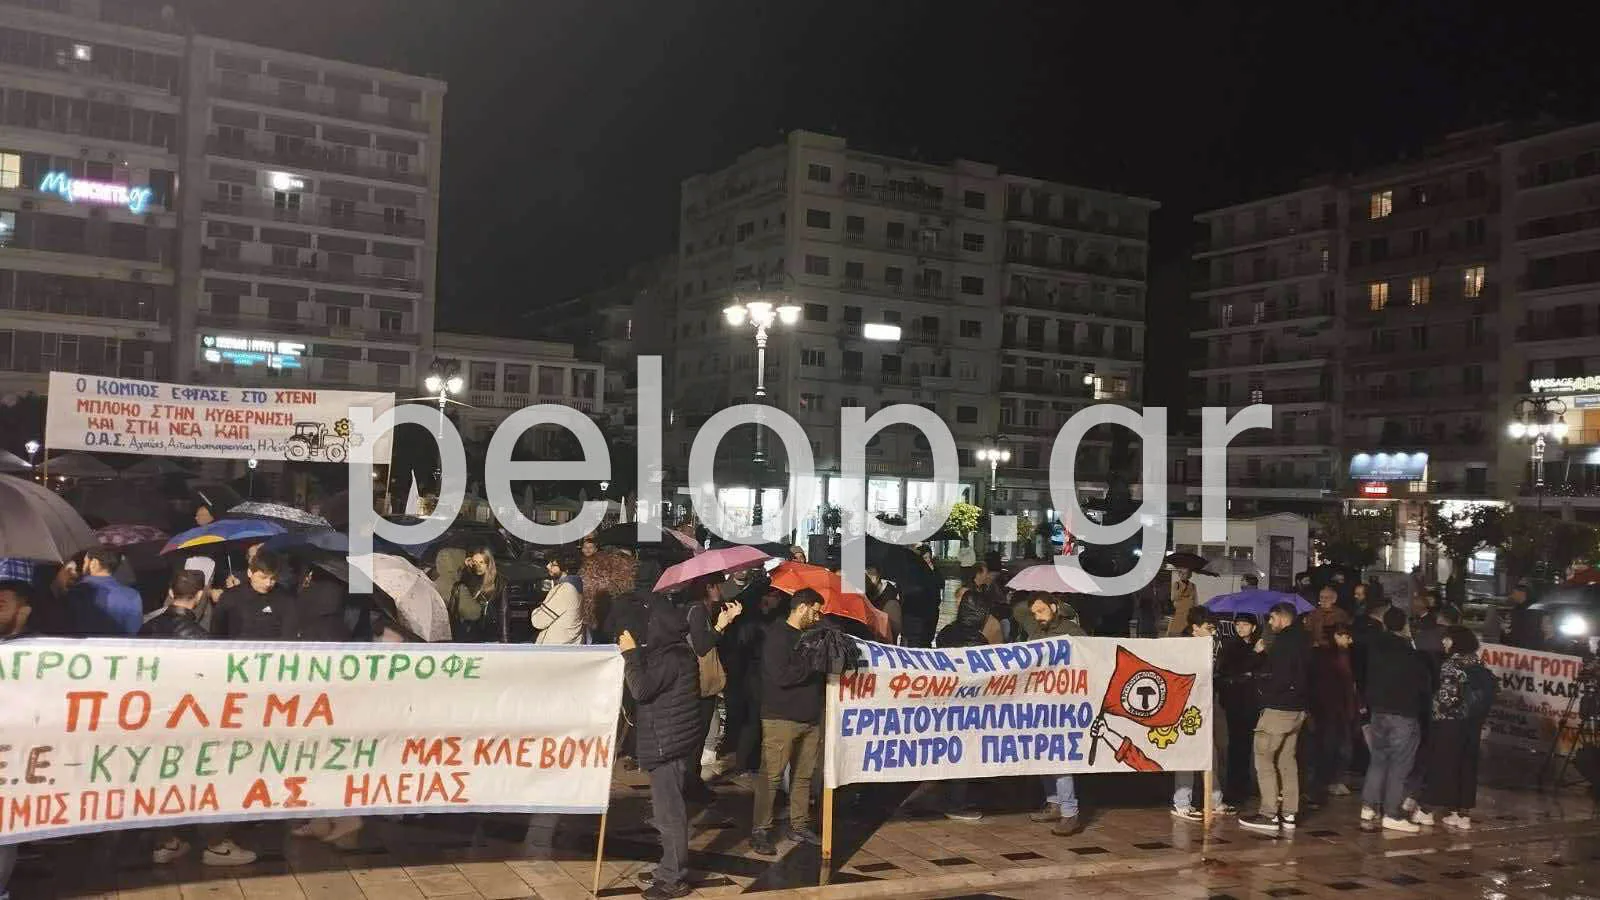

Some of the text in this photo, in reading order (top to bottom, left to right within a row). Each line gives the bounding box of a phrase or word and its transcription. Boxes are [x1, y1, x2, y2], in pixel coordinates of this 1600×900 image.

[76, 378, 317, 404] Ο ΚΟΜΠΟΣ ΕΦΤΑΣΕ ΣΤΟ ΧΤΕΝΙ
[77, 399, 294, 426] ΜΠΛΟΚΟ ΣΤΗΝ ΚΥΒΕΡΝΗΣΗ
[88, 416, 249, 440] ΚΑΙ ΣΤΗ ΝΕΑ ΚΑΠ
[0, 651, 483, 684] ΓΡΟΤΗ ΚΤΗΝΟΤΡΟΦΕ
[852, 638, 1071, 674] ΡΓΑΤΙΑ-ΑΓΡΟΤΙΑ
[840, 671, 877, 701] ΜΙΑ
[889, 672, 959, 699] ΦΩΝΗ
[983, 673, 1018, 697] ΜΙΑ
[1024, 668, 1088, 696] ΓΡΟΘΙΑ
[66, 690, 334, 733] ΠΟΛΕΜΑ
[401, 736, 463, 767] ΜΑΣ
[474, 736, 611, 770] ΚΛΕΒΟΥΝ
[862, 731, 1084, 772] ΚΕΝΤΡΟ ΠΑΤΡΑΣ
[0, 783, 219, 832] ΜΟΣΠΟΝΔΙΑ
[344, 772, 471, 807] ΗΛΕΙΑΣ
